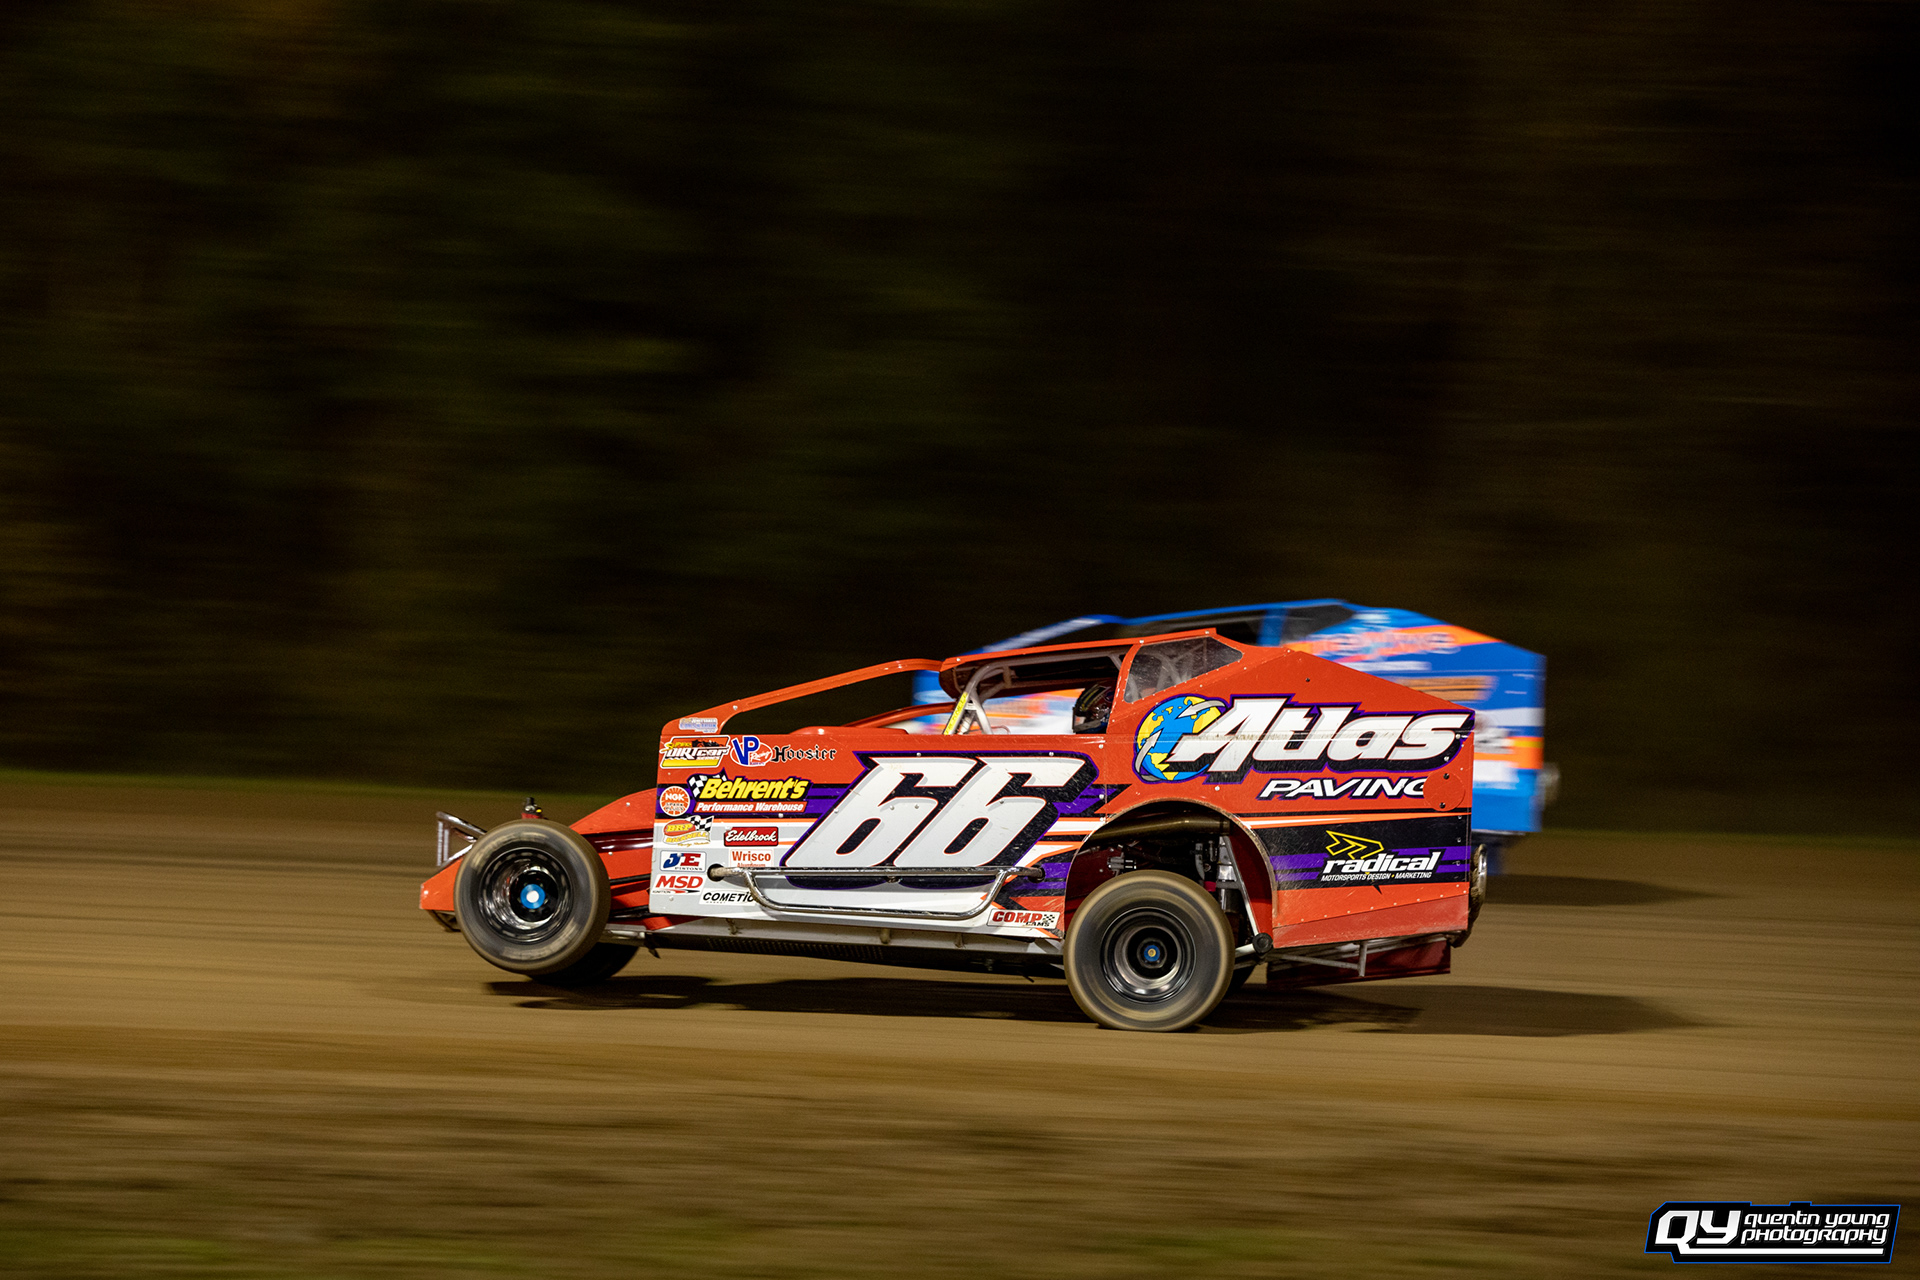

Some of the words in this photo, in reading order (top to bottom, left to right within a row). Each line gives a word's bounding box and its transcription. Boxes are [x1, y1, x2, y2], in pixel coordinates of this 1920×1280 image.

[1166, 697, 1470, 772] Atlas
[731, 736, 760, 766] VP
[770, 746, 837, 763] Hoosier
[700, 777, 809, 800] Behrent's
[665, 793, 685, 801] NGK
[696, 802, 753, 812] Performance
[755, 802, 804, 812] Warehouse
[784, 757, 1086, 868] 66
[666, 823, 694, 833] BRP
[726, 829, 777, 842] Edelbrock
[663, 852, 701, 869] JE
[732, 851, 771, 862] Wrisco
[1323, 851, 1441, 874] radical
[655, 875, 704, 889] MSD
[1321, 873, 1366, 882] MOTORSPORTS
[1367, 872, 1391, 880] DESIGN
[1395, 871, 1432, 879] MARKETING
[992, 911, 1043, 923] COMP
